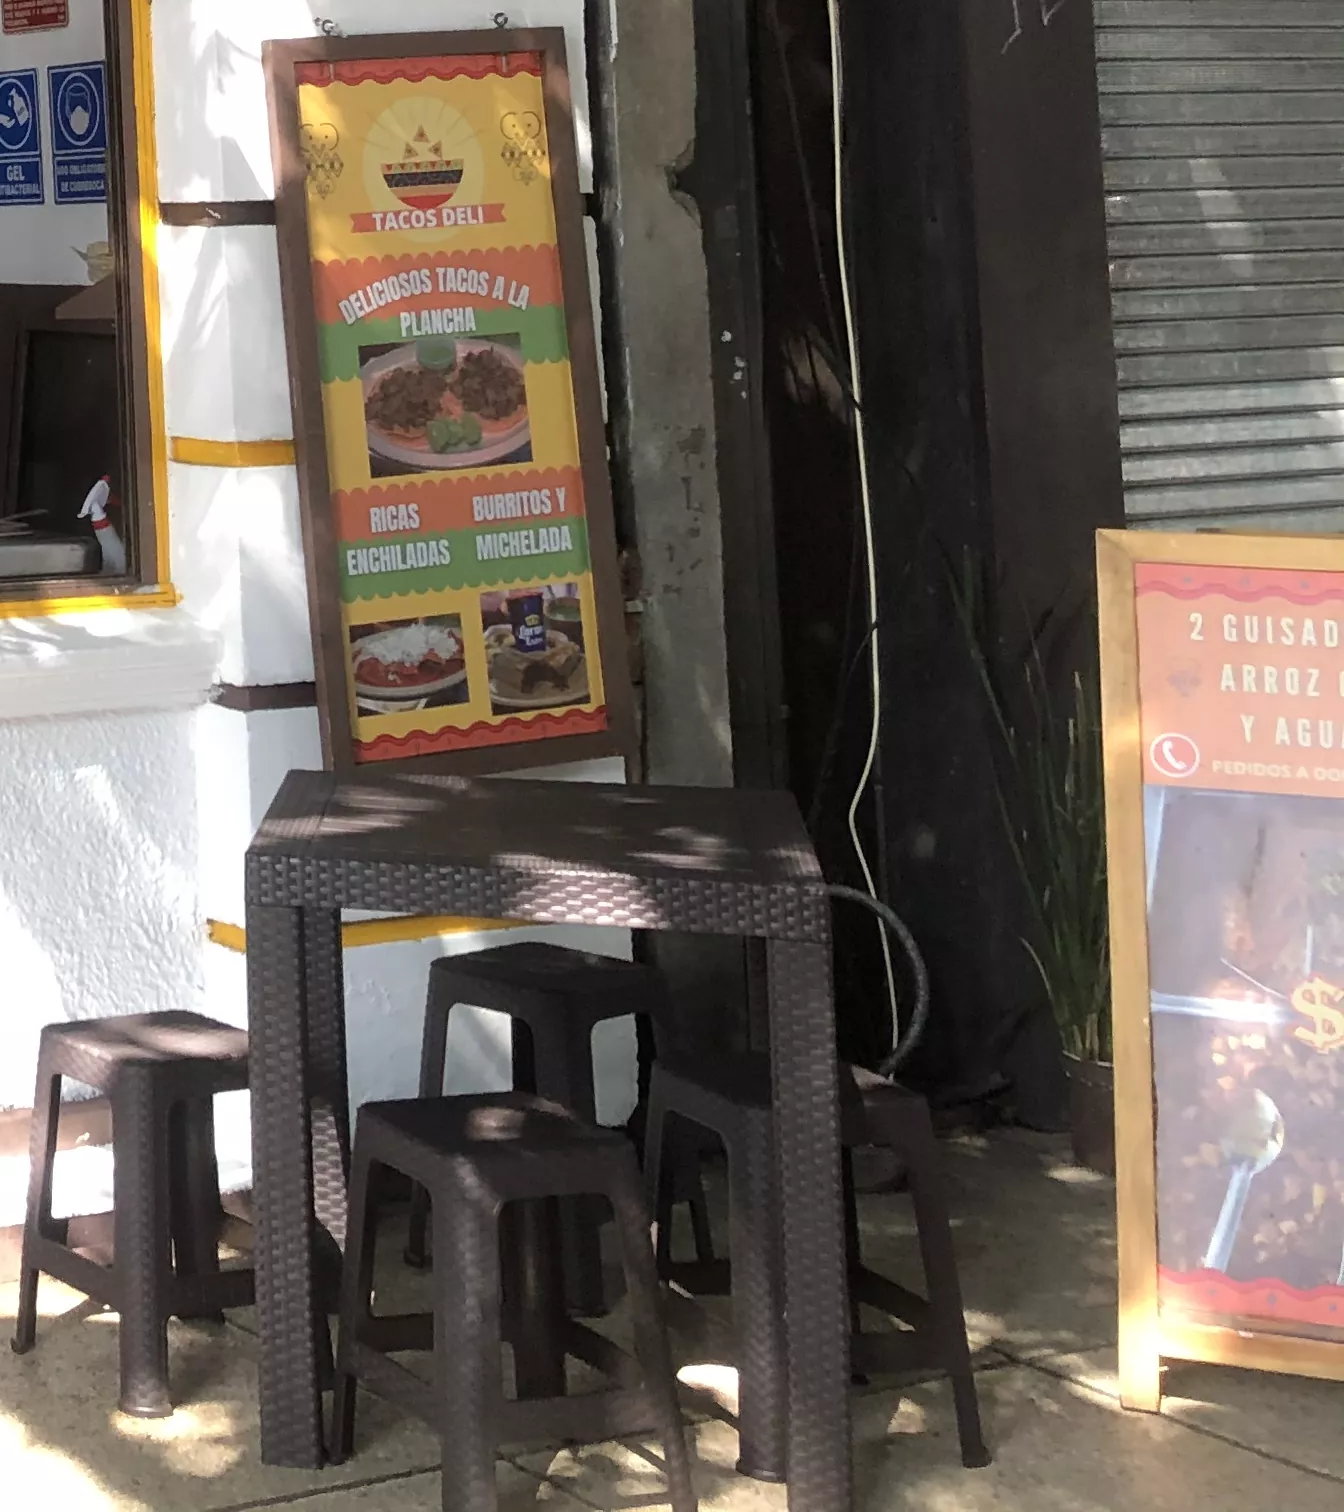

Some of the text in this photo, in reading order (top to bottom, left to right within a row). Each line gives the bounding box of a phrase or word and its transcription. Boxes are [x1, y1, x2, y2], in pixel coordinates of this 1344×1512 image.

[6, 165, 25, 182] GEL
[371, 206, 484, 232] TACOS DELI
[339, 266, 531, 326] DELICIOSOS TACOS A LA
[399, 308, 476, 338] PLANCHA
[369, 503, 421, 534] RICAS
[472, 489, 568, 524] BURRITOS Y
[345, 540, 451, 576] ENCHILADAS
[475, 535, 573, 562] MICHELADA
[1189, 612, 1339, 648] 2 GUISAD
[1220, 663, 1320, 697] ARROZ
[1240, 713, 1344, 750] Y AGU
[1212, 759, 1292, 779] PEDIDOS
